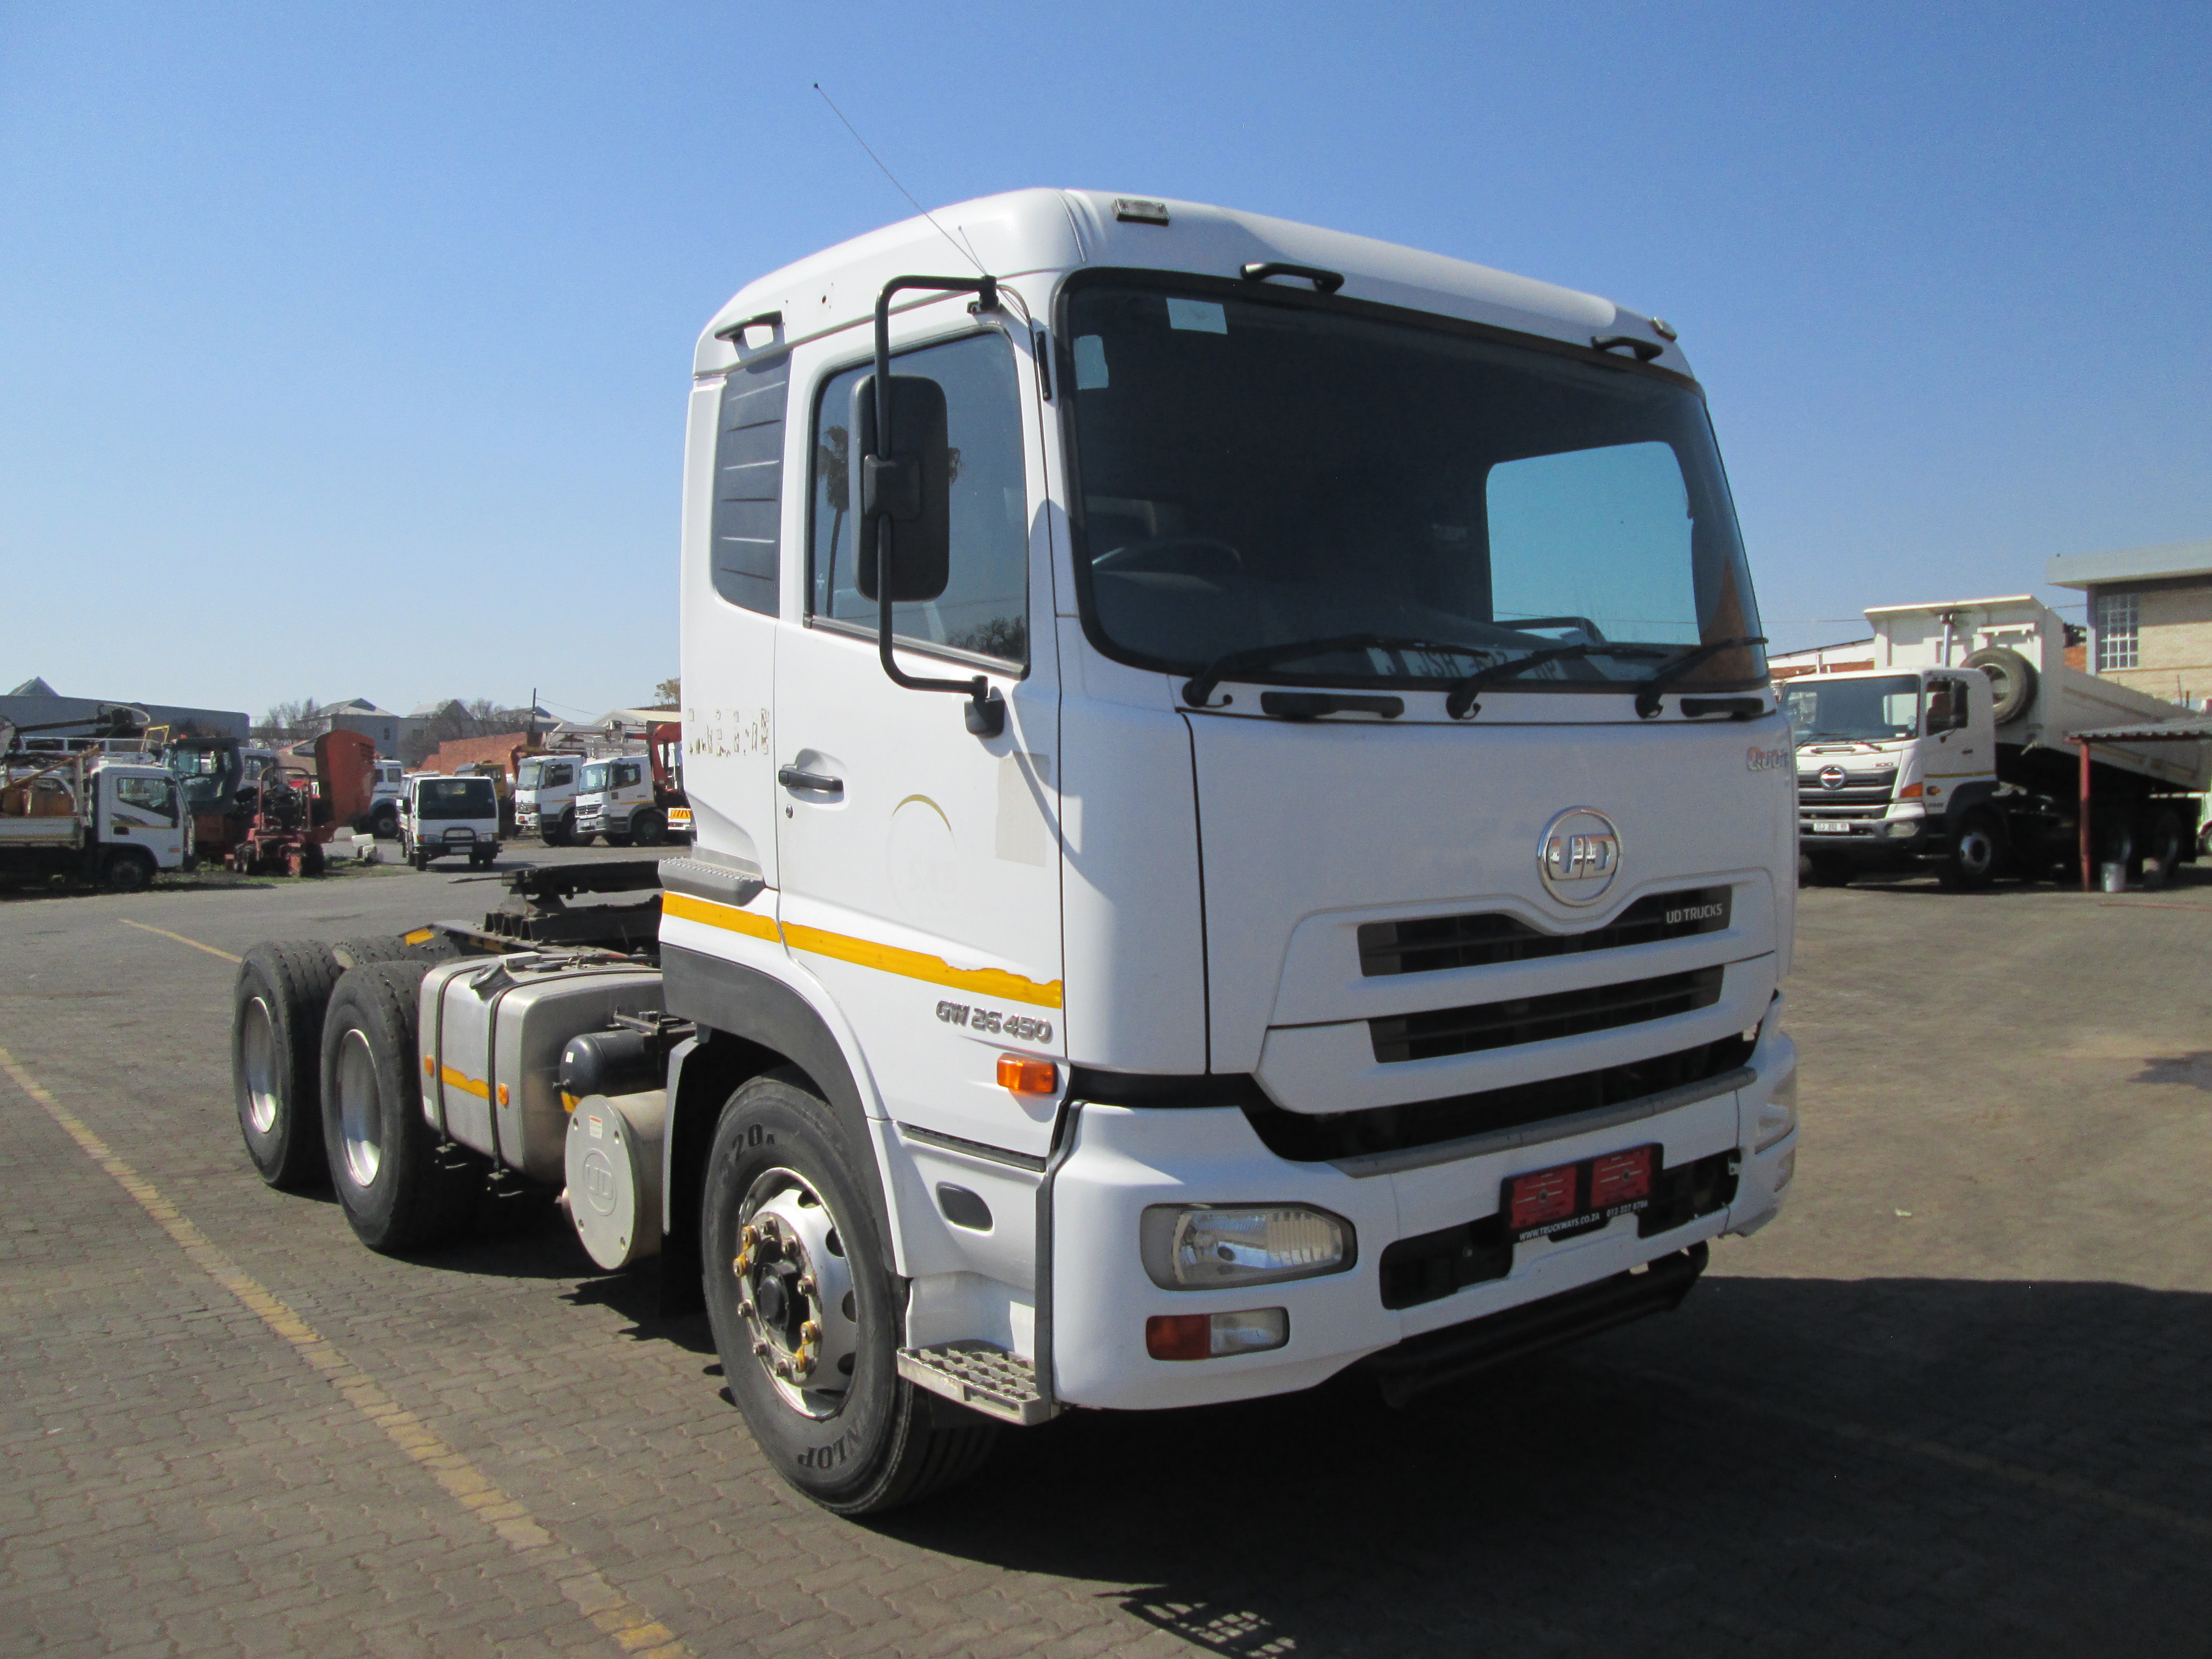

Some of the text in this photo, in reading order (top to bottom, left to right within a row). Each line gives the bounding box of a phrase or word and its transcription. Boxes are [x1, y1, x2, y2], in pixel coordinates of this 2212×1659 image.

[1547, 833, 1619, 880] UD
[1666, 903, 1723, 924] UD TRUCKS
[936, 999, 1054, 1044] GW 26 450
